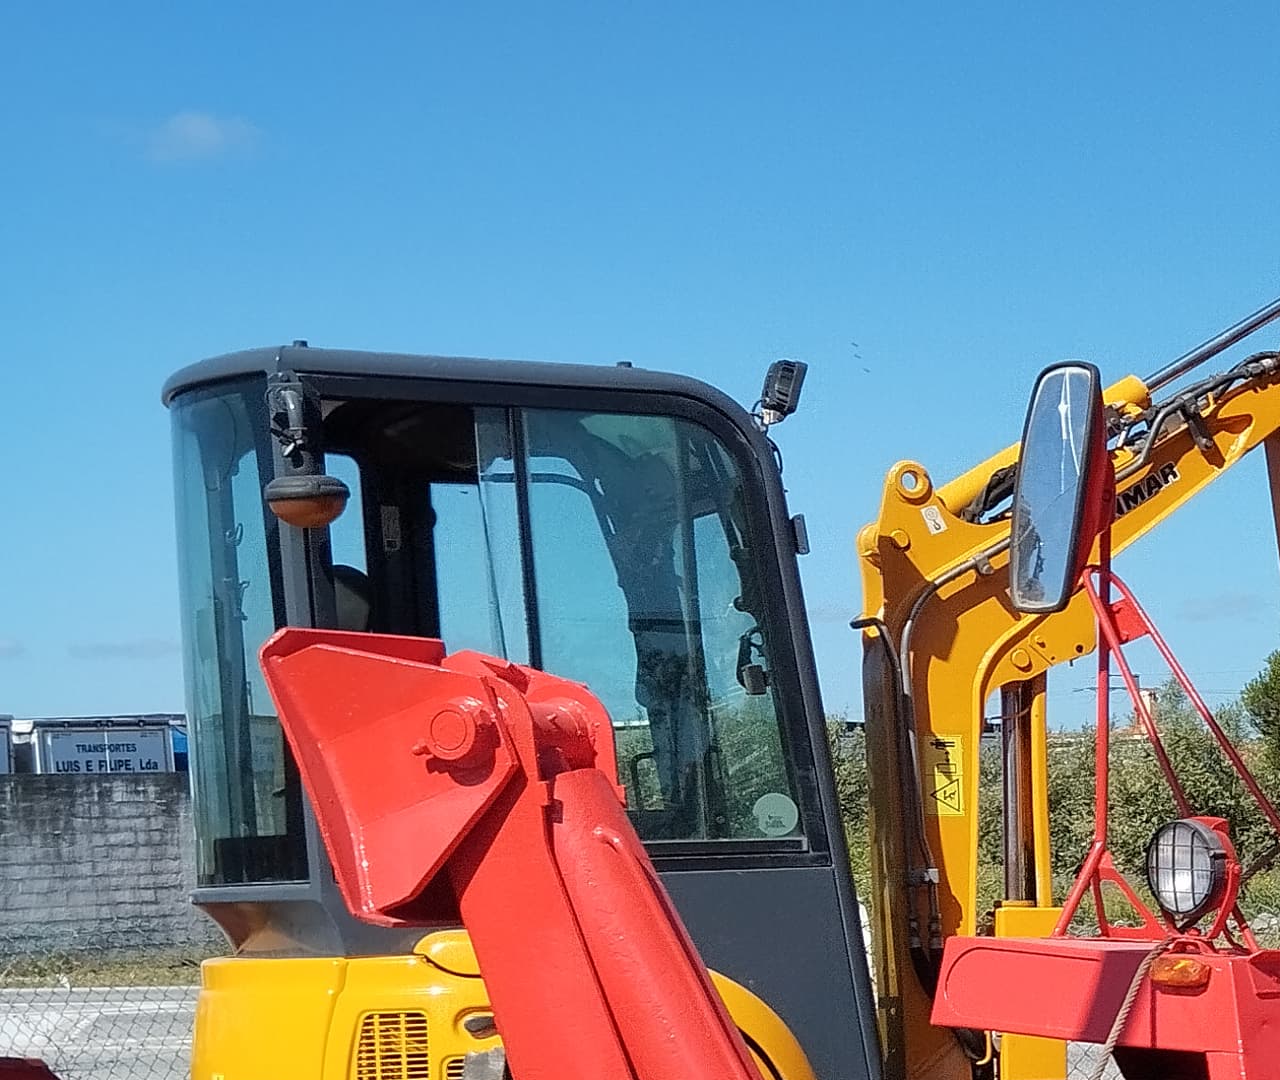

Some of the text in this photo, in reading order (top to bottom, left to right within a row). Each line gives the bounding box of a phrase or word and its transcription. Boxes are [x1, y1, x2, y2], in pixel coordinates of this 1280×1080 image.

[75, 743, 137, 753] TRANSPORTES
[55, 758, 159, 774] LUIS E FILIPE, Lda
